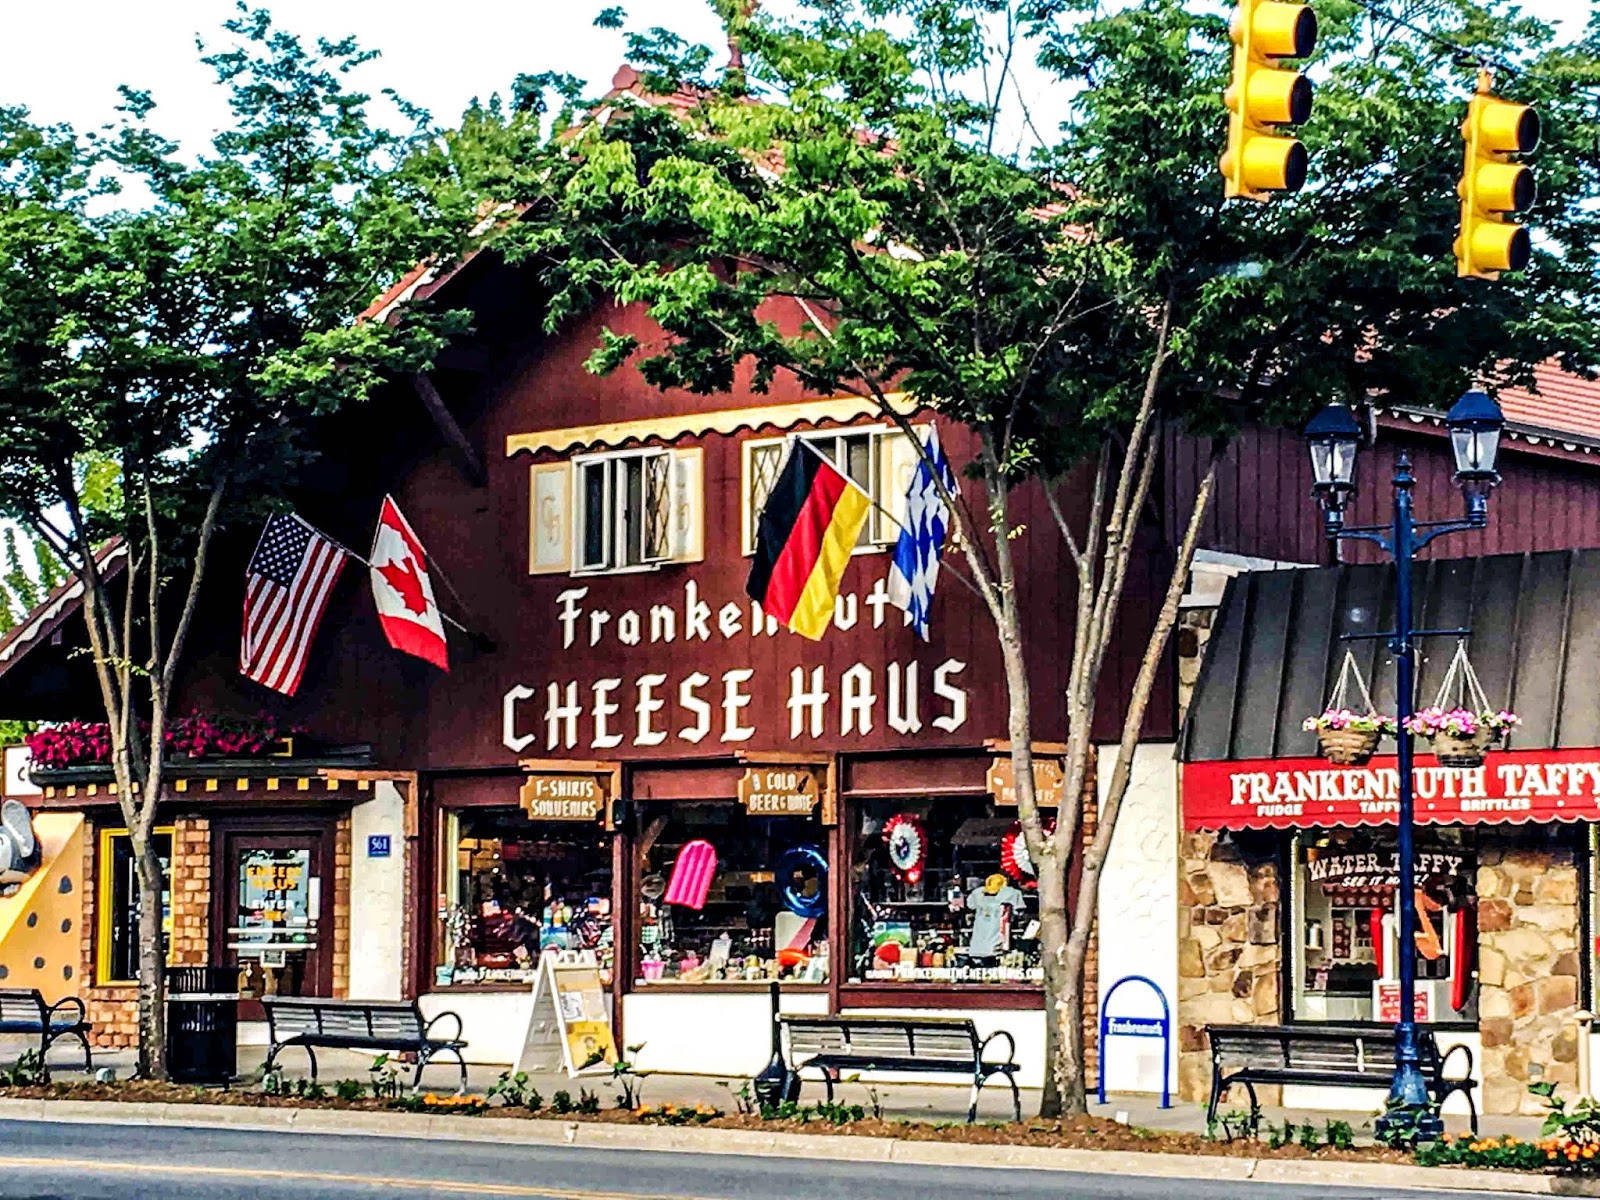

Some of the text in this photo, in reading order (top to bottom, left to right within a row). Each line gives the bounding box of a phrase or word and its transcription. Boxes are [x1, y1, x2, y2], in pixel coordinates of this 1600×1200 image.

[556, 579, 913, 649] Frankenut
[502, 657, 968, 753] CHEESE HAUS
[535, 779, 594, 798] T-SHIRTS
[766, 772, 796, 791] COLD
[531, 799, 597, 818] SOUVENIRS
[749, 793, 780, 812] BEER
[1257, 803, 1303, 817] FUDGE
[1460, 798, 1532, 812] BRITTLES
[1308, 852, 1463, 882] WATER TFFY
[1341, 875, 1367, 888] SEE
[1369, 875, 1384, 886] IT
